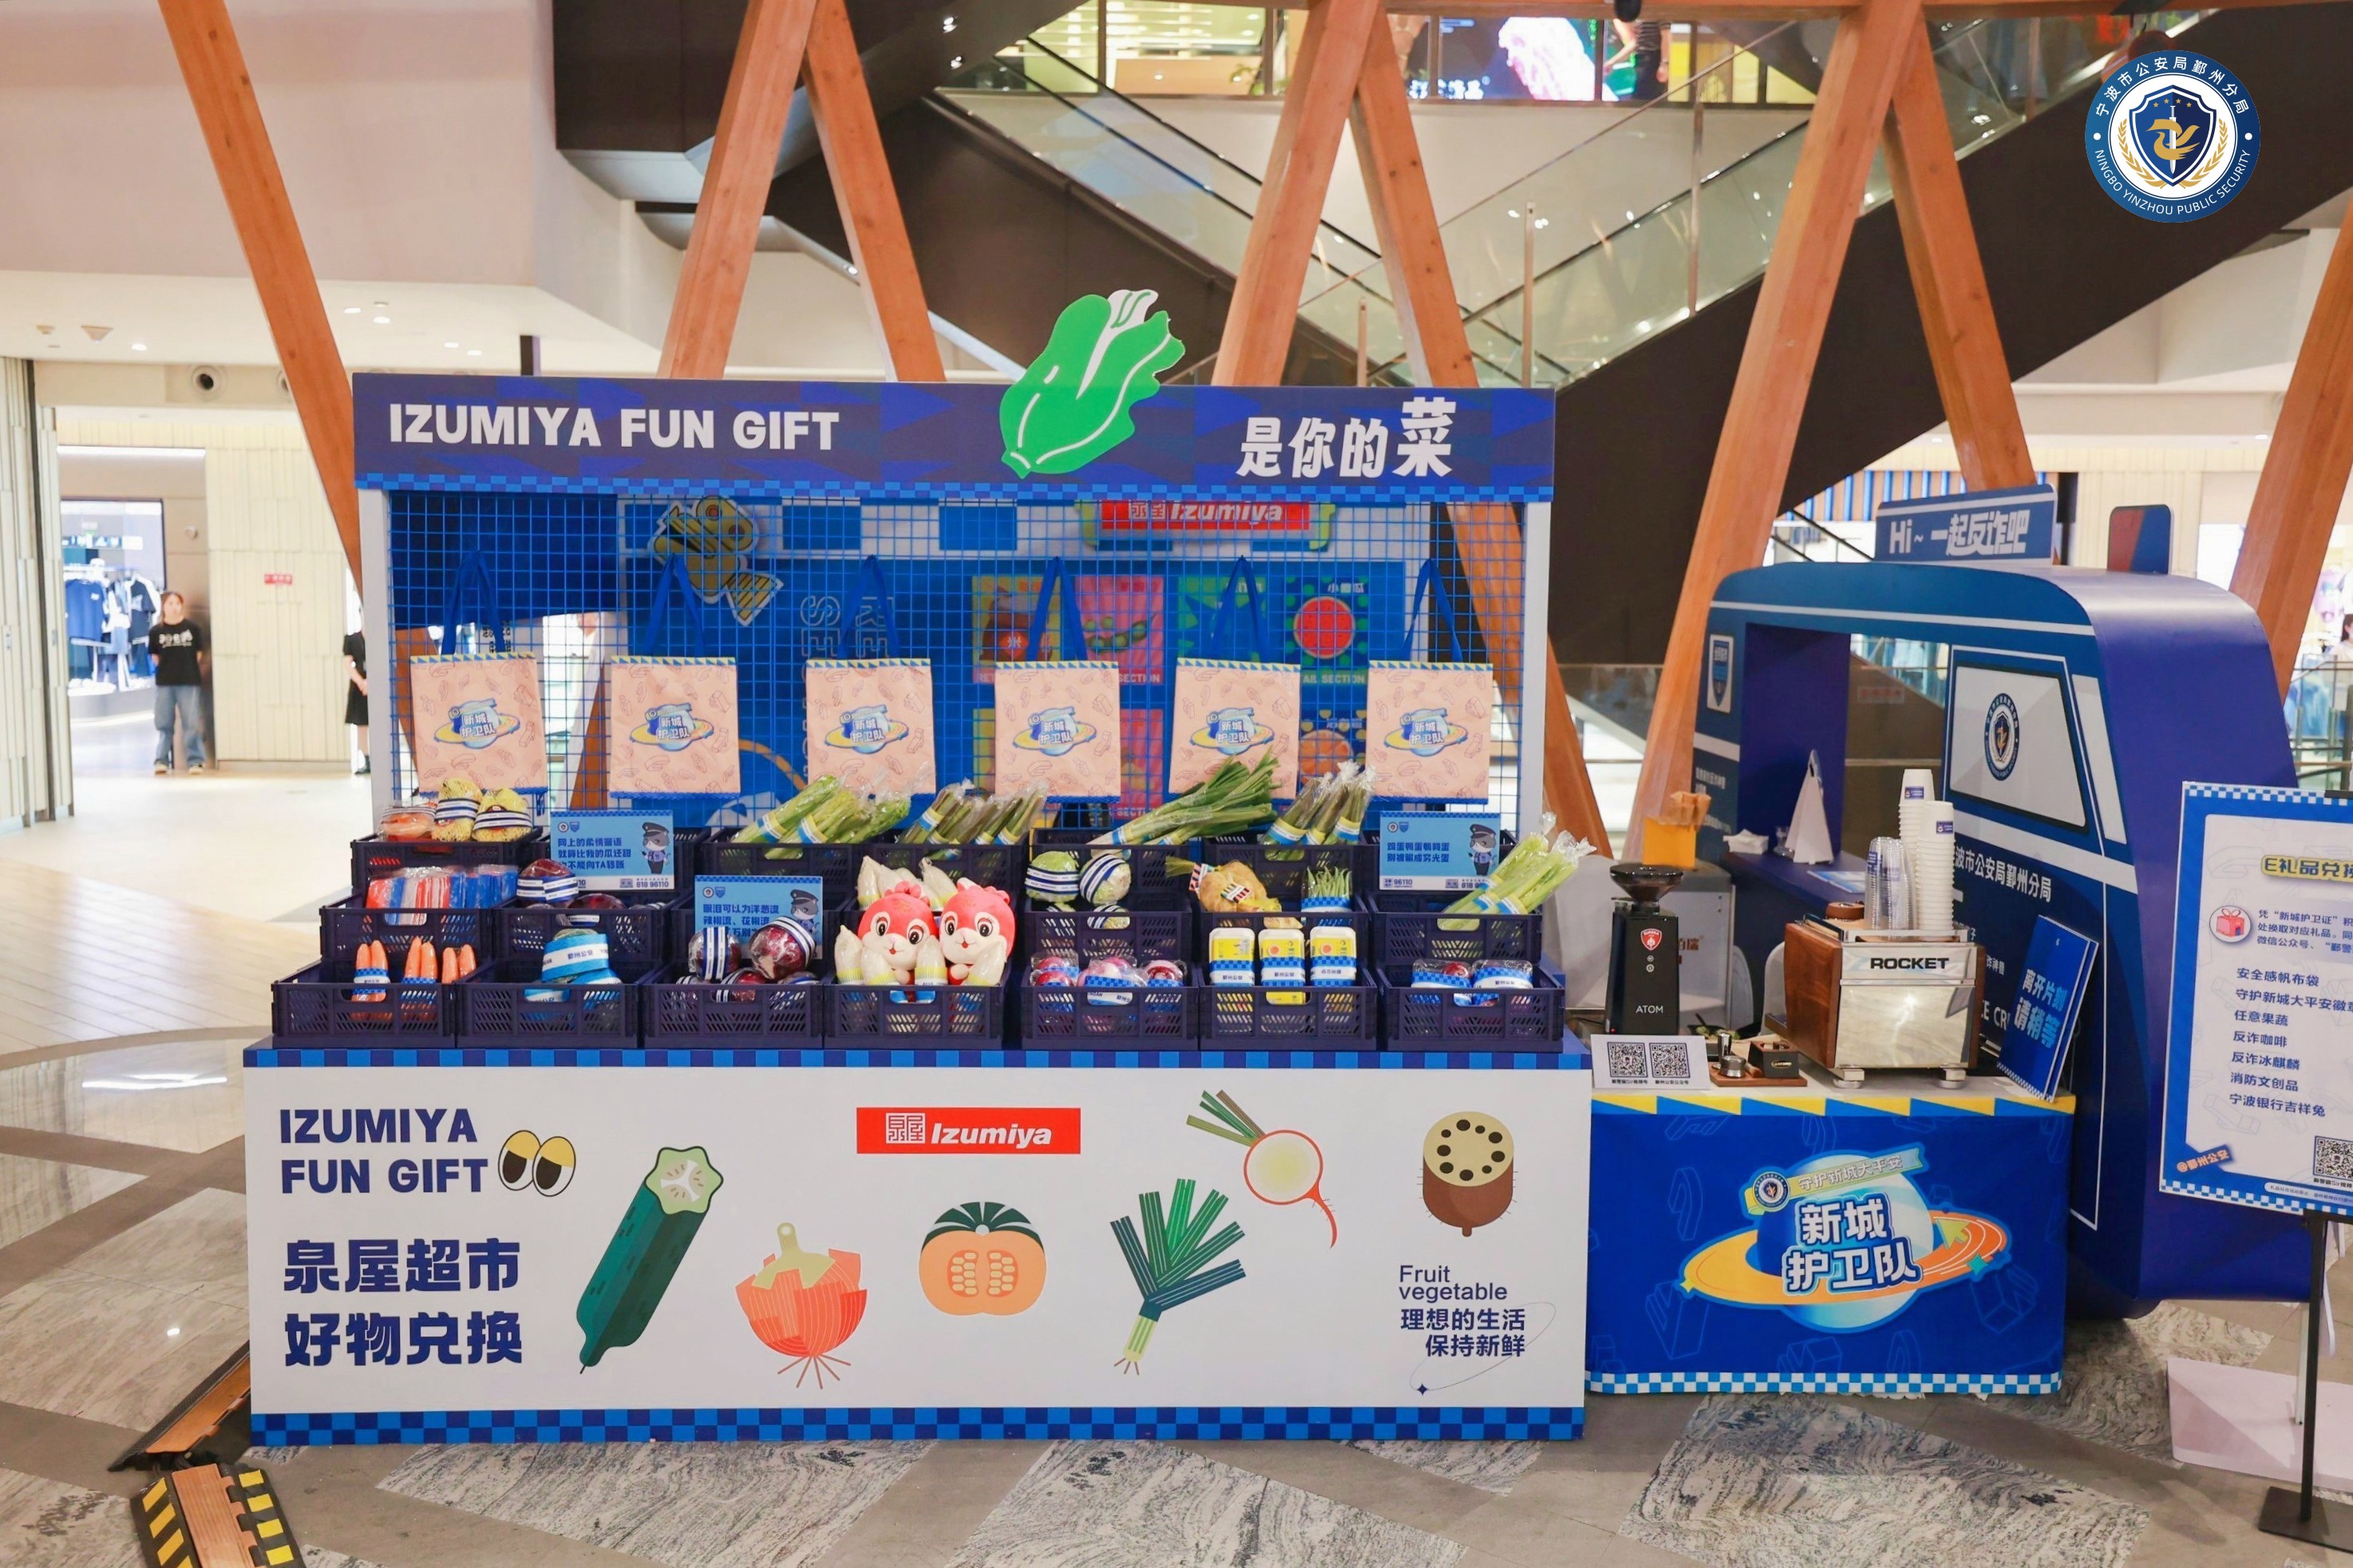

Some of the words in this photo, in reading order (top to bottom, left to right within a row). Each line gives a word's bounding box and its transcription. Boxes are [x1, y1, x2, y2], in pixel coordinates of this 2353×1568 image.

[390, 403, 602, 447] IZUMIYA
[619, 409, 715, 449] FUN
[733, 410, 840, 452] GIFT
[1236, 396, 1457, 479] 是你的菜
[1170, 500, 1283, 526] Izumiya
[1931, 509, 2031, 557] 一起反诈吧
[1321, 674, 1366, 685] SECTION
[463, 712, 488, 726] 新城
[660, 715, 683, 729] 新城
[853, 717, 877, 731] 新城
[1042, 720, 1066, 733] 新城
[1220, 720, 1244, 733] 新城
[1414, 720, 1438, 733] 新城
[460, 724, 496, 739] 护卫队
[656, 726, 690, 740] 护卫队
[850, 729, 884, 743] 护卫队
[1038, 731, 1074, 745] 护卫队
[1216, 731, 1250, 745] 护卫队
[1410, 731, 1445, 745] 护卫队
[1955, 846, 2051, 902] 波市公安局鄞州分局
[2256, 935, 2353, 954] 微信公众号、“鄞警
[1870, 958, 1949, 970] ROCKET
[2236, 968, 2319, 987] 安全感帆布袋
[2022, 968, 2068, 1012] 离开片刻
[1635, 1005, 1663, 1014] ATOM
[2234, 1009, 2289, 1027] 任意果蔬
[2014, 997, 2062, 1049] 请稍等
[2232, 1030, 2288, 1048] 反诈咖啡
[2232, 1051, 2300, 1071] 反诈冰麒麟
[2230, 1072, 2299, 1092] 消防文创品
[2229, 1093, 2326, 1117] 宁波银行吉祥兔
[279, 1108, 478, 1143] IZUMIYA
[931, 1123, 1053, 1149] Izumiya
[281, 1159, 370, 1194] FUN
[388, 1158, 488, 1194] GIFT
[1797, 1154, 1904, 1191] 守护新城大平安
[1800, 1198, 1888, 1245] 新城
[283, 1238, 520, 1294] 泉屋超市
[1399, 1265, 1450, 1283] Fruit
[1786, 1245, 1916, 1292] 护卫队
[1398, 1282, 1508, 1303] vegetable
[1400, 1307, 1526, 1331] 理想的生活
[284, 1311, 523, 1367] 好物兑换
[1425, 1333, 1525, 1357] 保持新鲜
